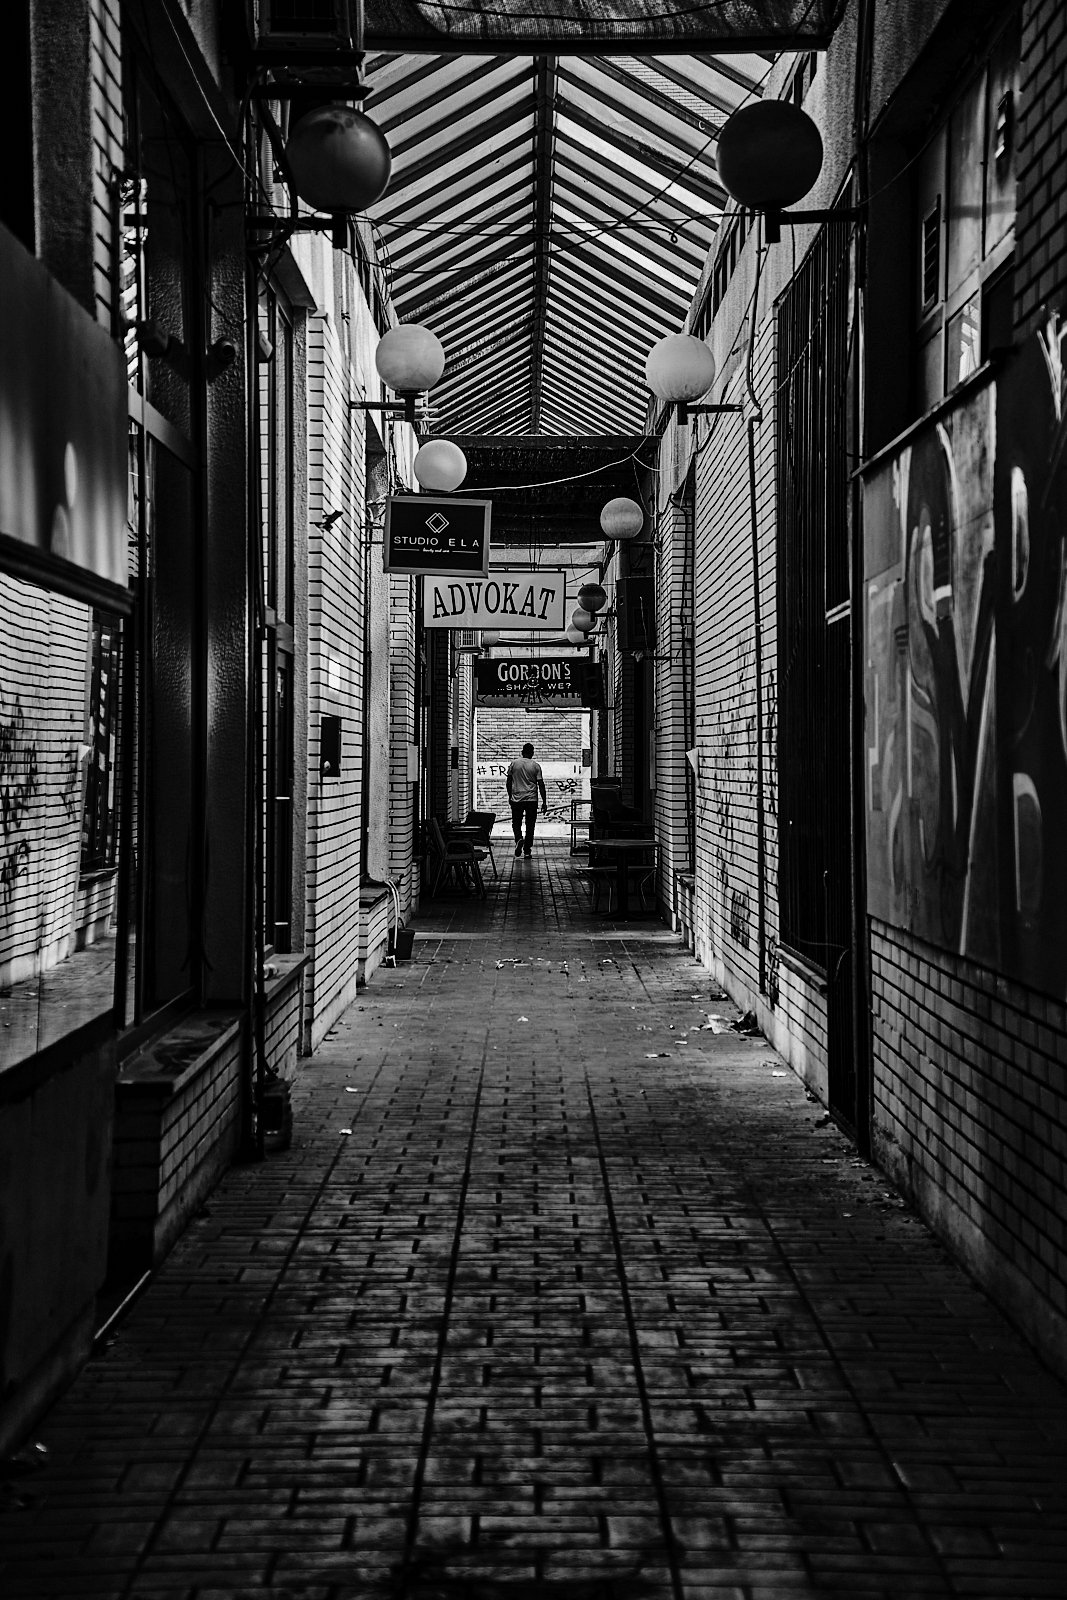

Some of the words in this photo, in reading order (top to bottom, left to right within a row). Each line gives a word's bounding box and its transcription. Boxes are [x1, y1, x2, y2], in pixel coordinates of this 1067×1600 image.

[393, 536, 439, 546] STUDIO
[432, 581, 556, 620] ADVOKAT
[547, 682, 572, 690] WE?
